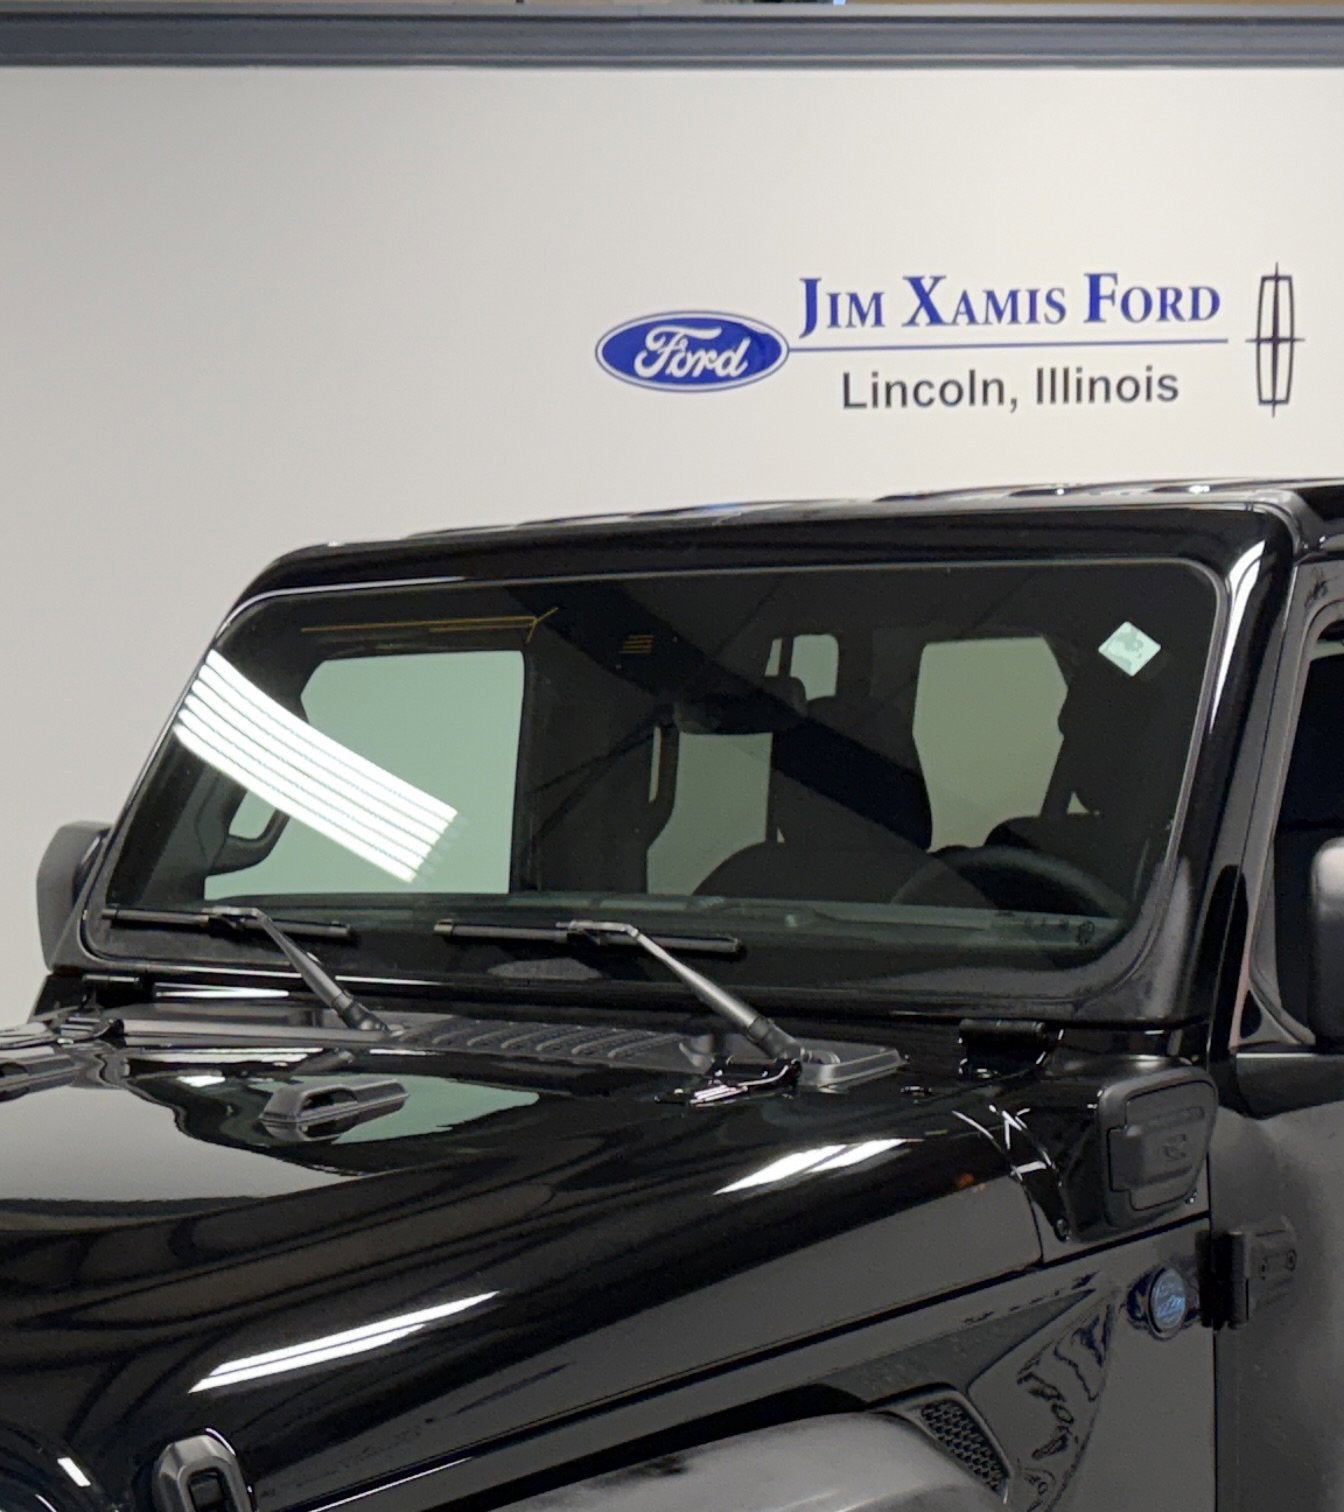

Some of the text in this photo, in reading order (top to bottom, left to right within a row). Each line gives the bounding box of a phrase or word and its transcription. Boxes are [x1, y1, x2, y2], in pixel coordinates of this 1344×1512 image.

[632, 323, 749, 380] Ford
[841, 364, 1180, 413] Lincoln, Illinois
